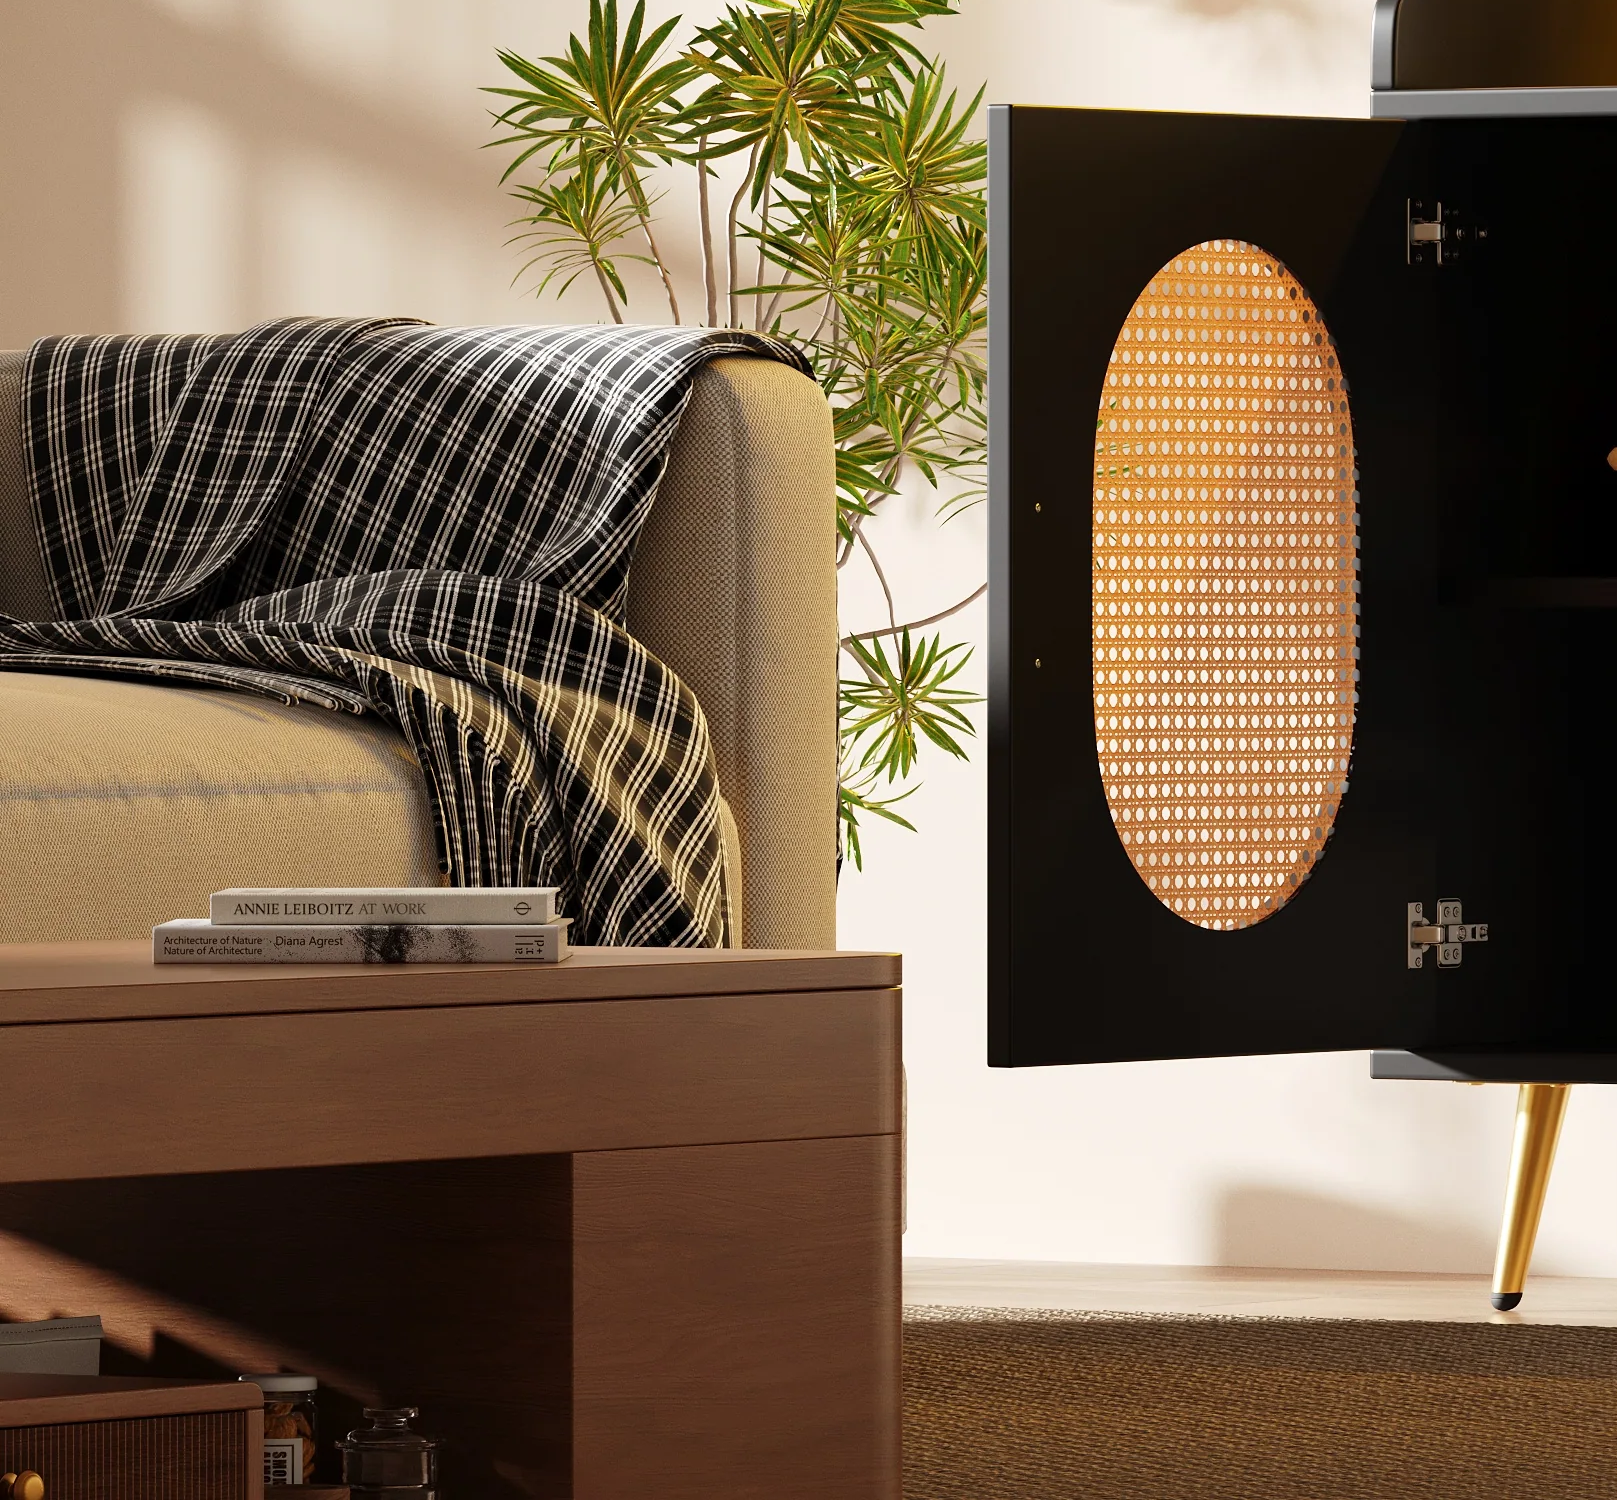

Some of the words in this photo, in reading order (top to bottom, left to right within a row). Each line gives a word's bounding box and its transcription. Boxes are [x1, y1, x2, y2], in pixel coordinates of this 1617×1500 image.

[233, 903, 280, 915] ANNIE
[284, 903, 354, 915] LEIBOITZ
[358, 903, 377, 915] AT
[382, 903, 427, 915] WORK
[163, 936, 218, 945] Architecture
[219, 935, 231, 945] of
[232, 936, 263, 945] Nature
[275, 935, 306, 946] Diana
[308, 936, 344, 948] Agrest
[163, 946, 195, 955] Nature
[197, 946, 207, 955] of
[208, 946, 263, 955] Architecture
